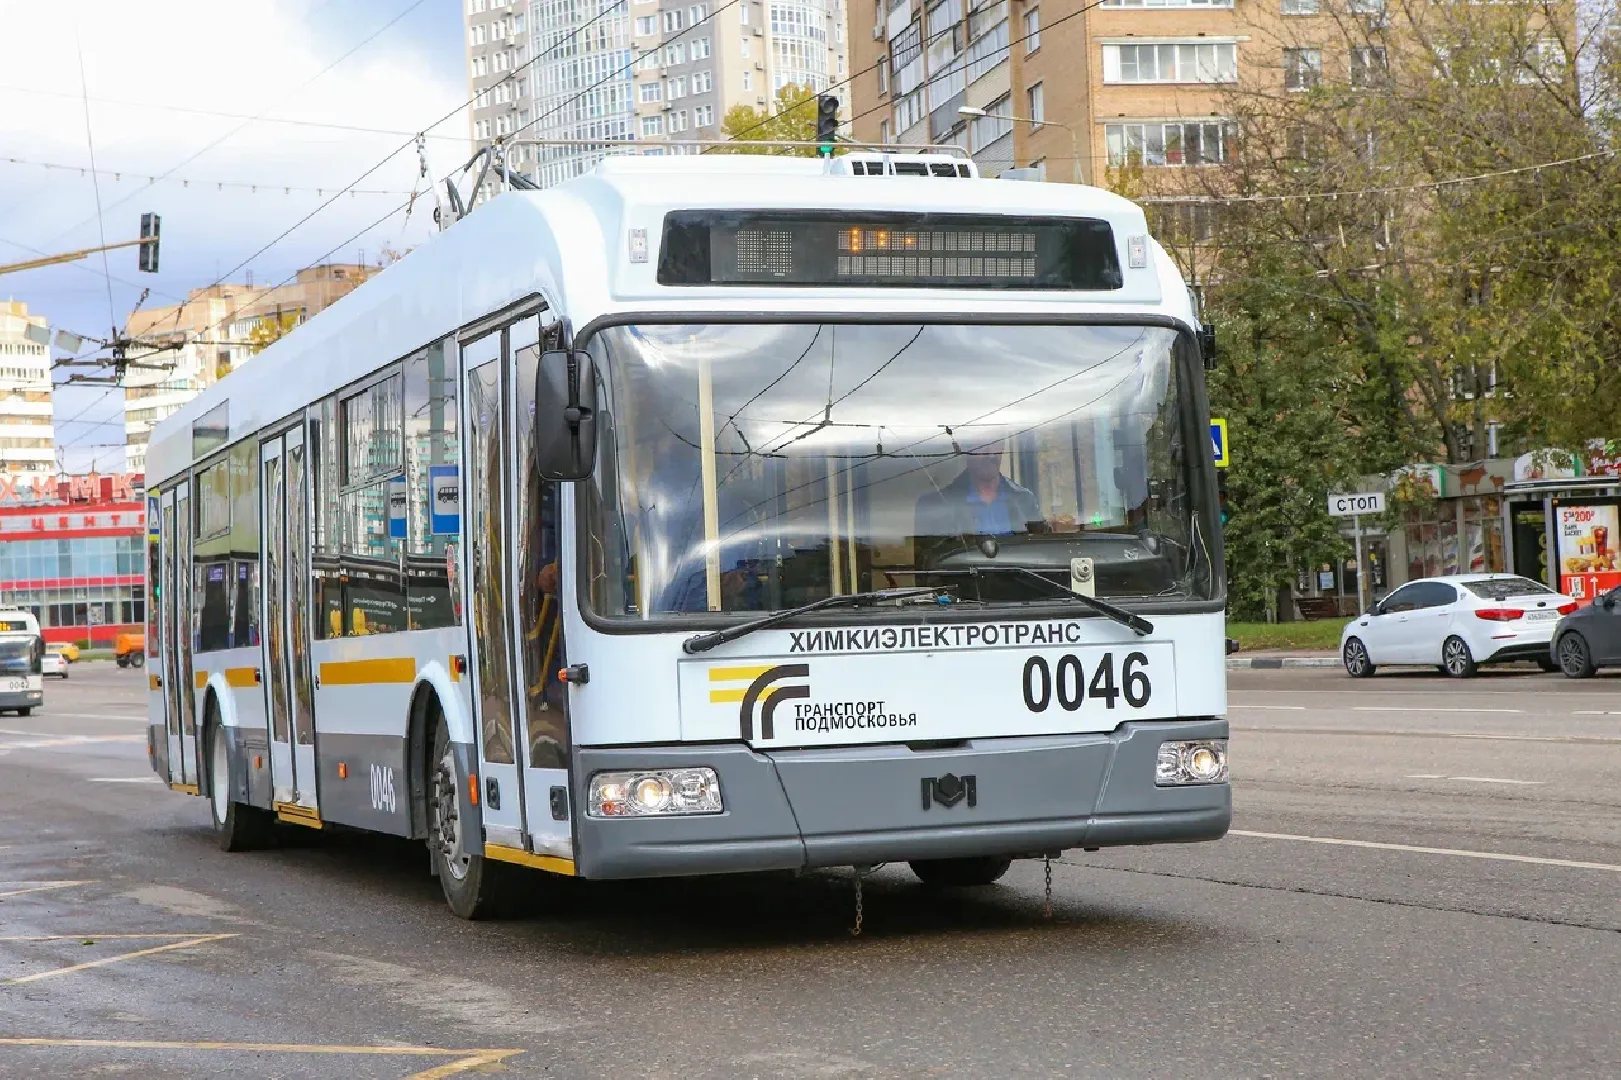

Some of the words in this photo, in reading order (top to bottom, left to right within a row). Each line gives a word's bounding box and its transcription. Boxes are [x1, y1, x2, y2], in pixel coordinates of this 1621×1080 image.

[1337, 496, 1377, 511] СТОП
[789, 622, 1081, 652] ХИМКИЭЛЕКТРОТРАНС
[1022, 651, 1151, 713] 0046
[794, 701, 885, 717] ТРАНСПОРТ
[795, 713, 917, 733] ПОДМОСКОВЬЯ
[370, 763, 396, 815] 0046
